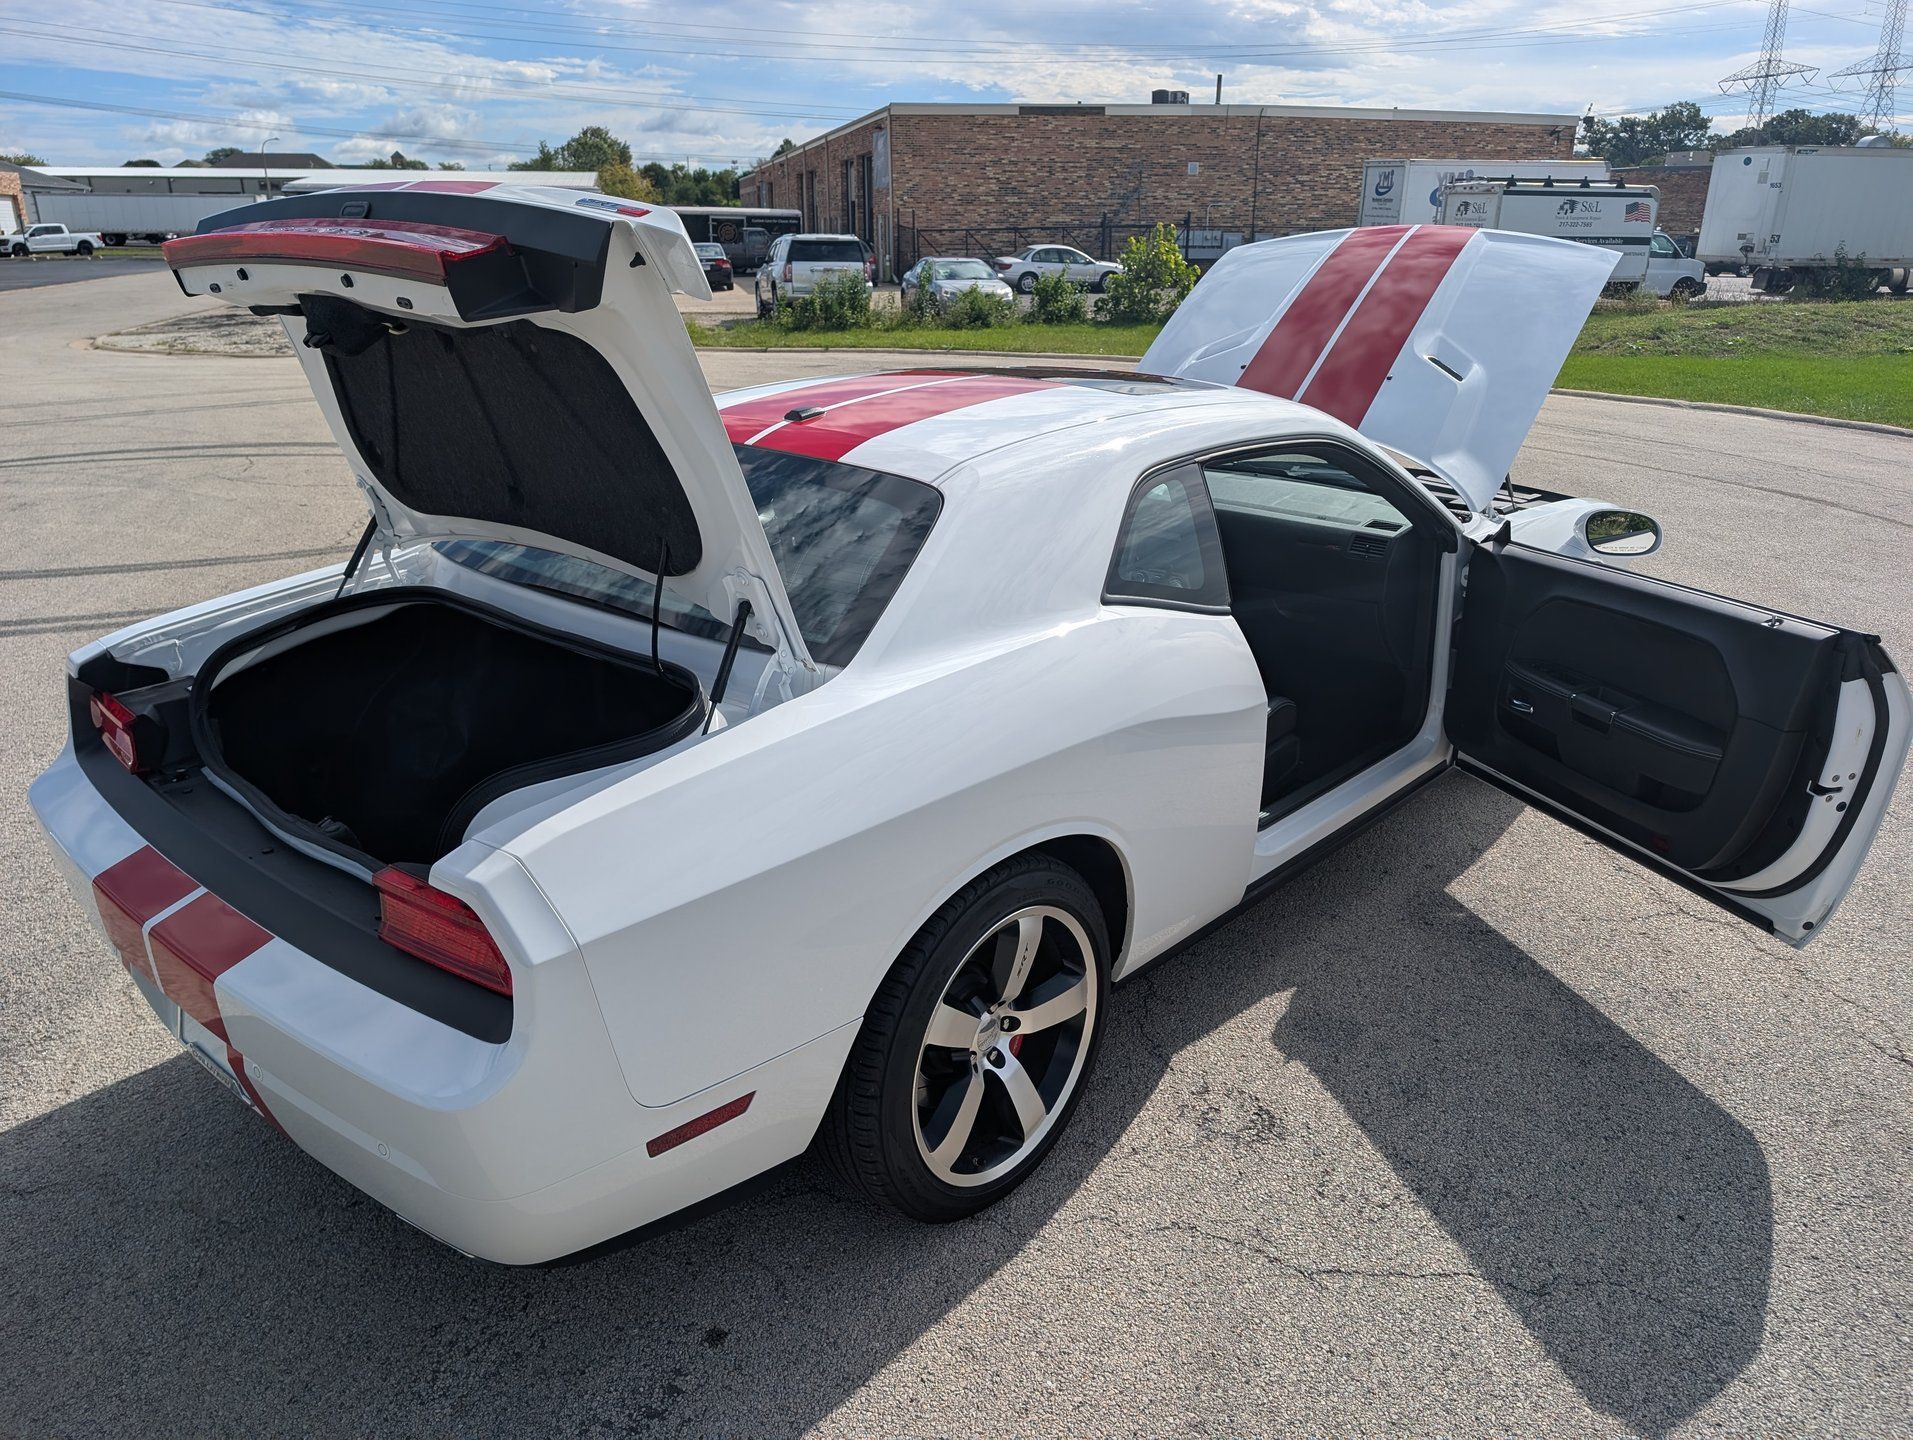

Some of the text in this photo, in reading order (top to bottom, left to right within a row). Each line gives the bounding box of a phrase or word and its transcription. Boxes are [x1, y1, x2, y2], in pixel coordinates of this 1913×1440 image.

[1471, 202, 1488, 214] S&L
[1580, 200, 1602, 213] S&L
[1599, 237, 1624, 245] Available
[1770, 234, 1781, 244] 53
